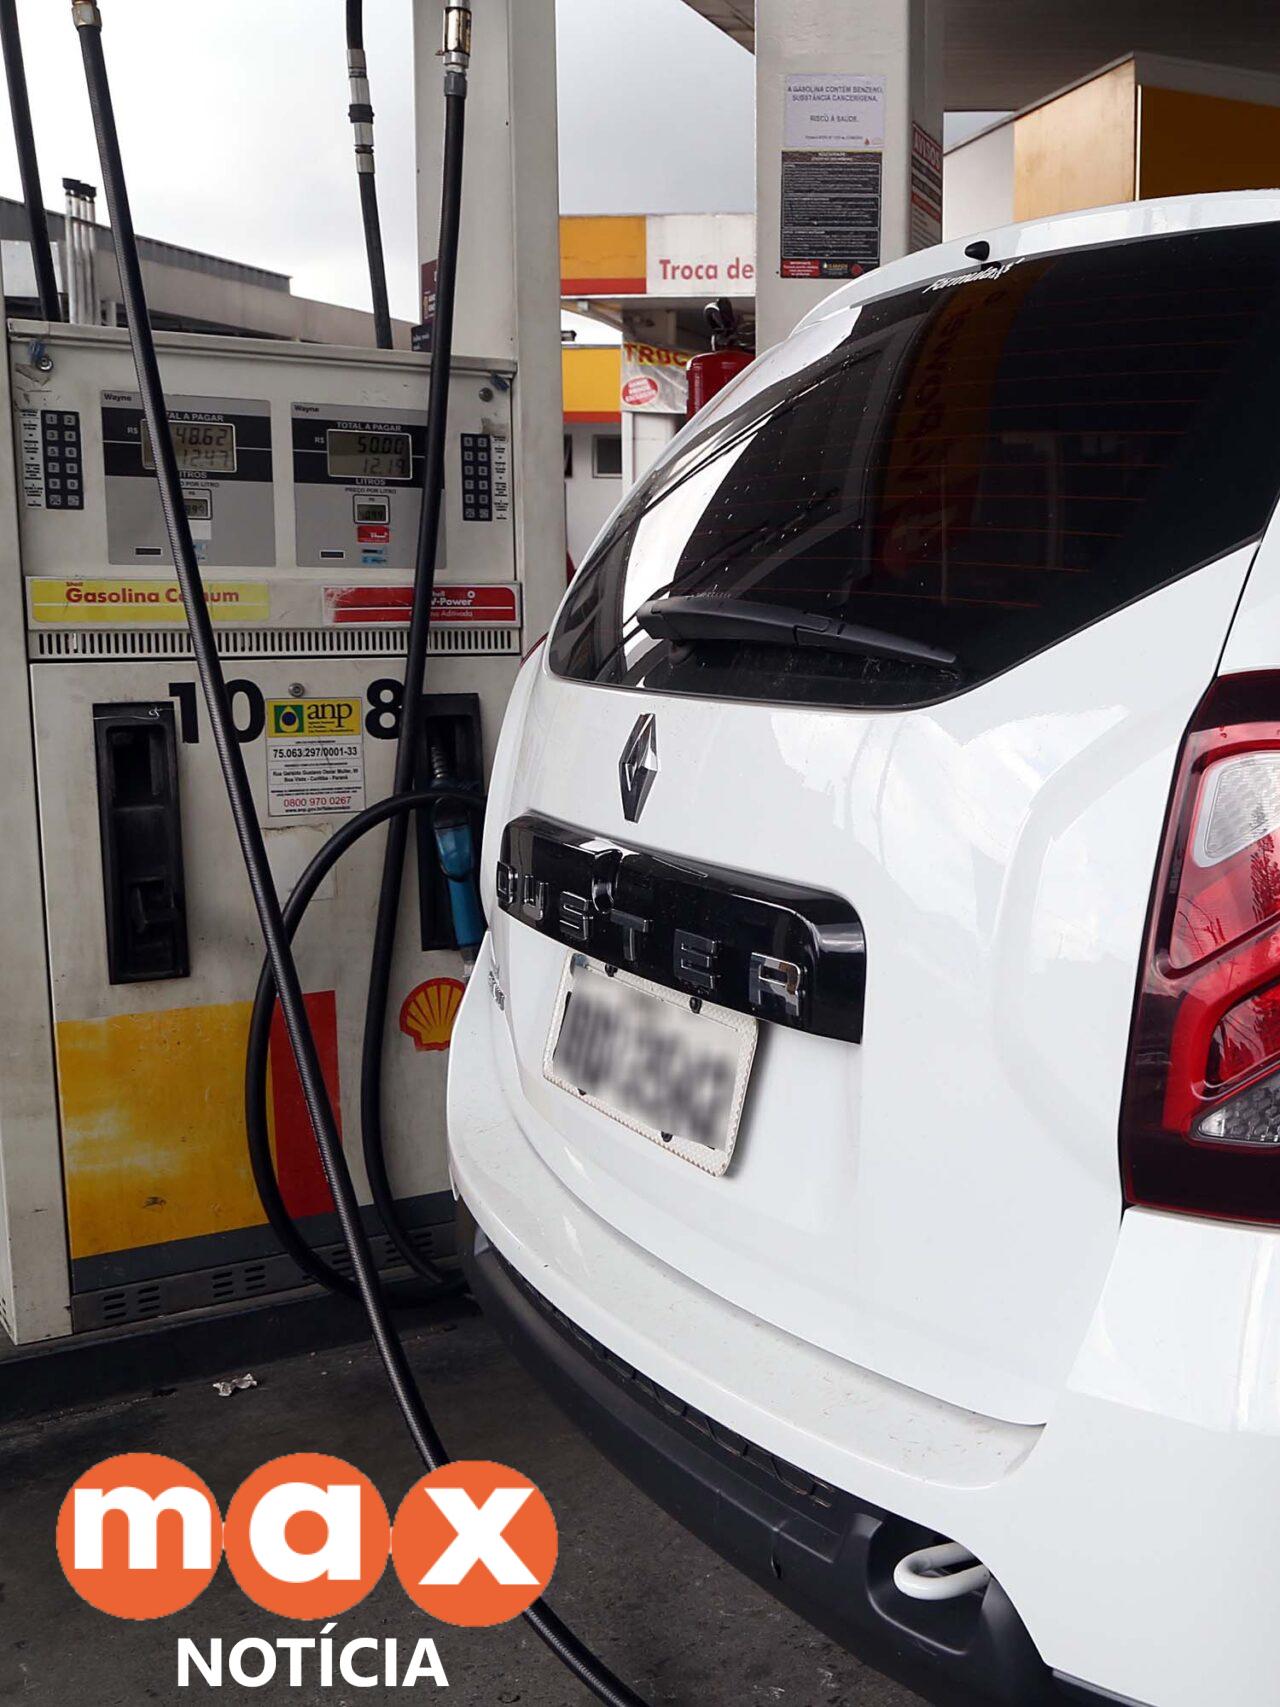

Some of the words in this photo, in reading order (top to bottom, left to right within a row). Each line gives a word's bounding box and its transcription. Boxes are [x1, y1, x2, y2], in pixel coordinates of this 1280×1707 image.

[793, 85, 824, 93] GASOLINA
[659, 259, 718, 280] Troca
[727, 257, 754, 280] de
[104, 393, 132, 402] Wayne
[294, 405, 320, 413] Wayne
[192, 413, 224, 422] PAGAR
[127, 427, 138, 435] R$
[337, 422, 362, 430] TOTAL
[372, 424, 402, 432] PAGAR
[176, 427, 228, 446] 48.62
[180, 470, 207, 479] ITROS
[355, 478, 386, 486] LITROS
[66, 588, 160, 603] Gasolina
[168, 678, 266, 743] 10
[365, 678, 405, 740] 8
[307, 702, 353, 728] anp
[273, 747, 358, 758] 75.063.297/0001-33
[283, 798, 307, 808] 0800
[309, 797, 327, 806] 970
[329, 796, 352, 805] 0267
[496, 860, 807, 1018] DUSTER
